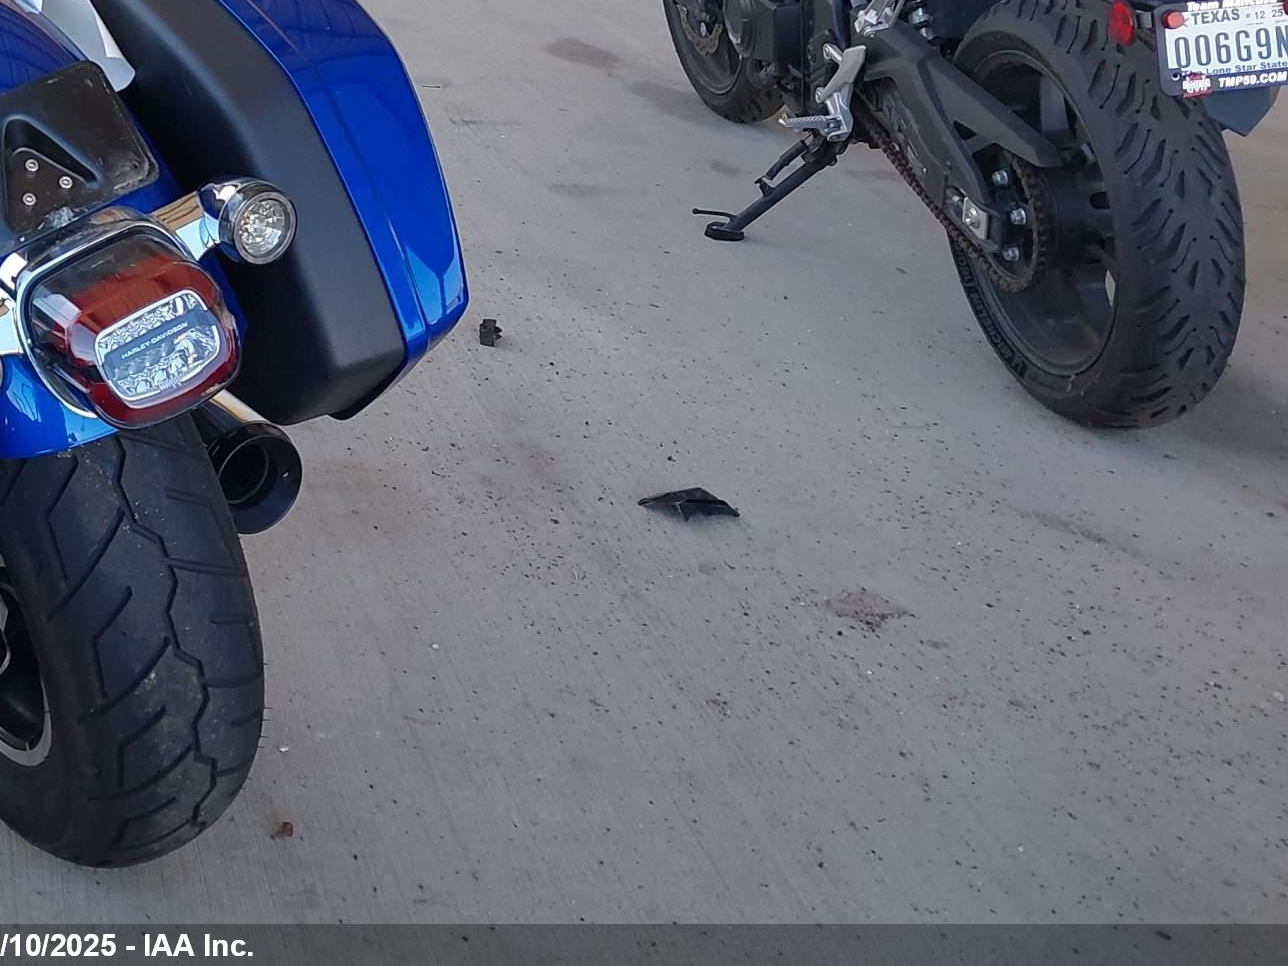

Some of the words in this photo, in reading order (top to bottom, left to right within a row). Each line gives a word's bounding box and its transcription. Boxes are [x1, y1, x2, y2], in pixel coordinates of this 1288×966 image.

[1186, 1, 1220, 12] Team
[1191, 9, 1241, 26] TEXAS
[1255, 10, 1266, 20] 12
[1272, 8, 1284, 18] 25
[1174, 25, 1288, 69] 006G9N
[1205, 67, 1232, 75] Lone
[1234, 63, 1256, 72] Star
[1259, 60, 1288, 70] State
[1217, 70, 1288, 89] TMP59.COM
[970, 294, 1014, 360] MICHELIN
[121, 321, 189, 360] HARLEY-DAVIDSON
